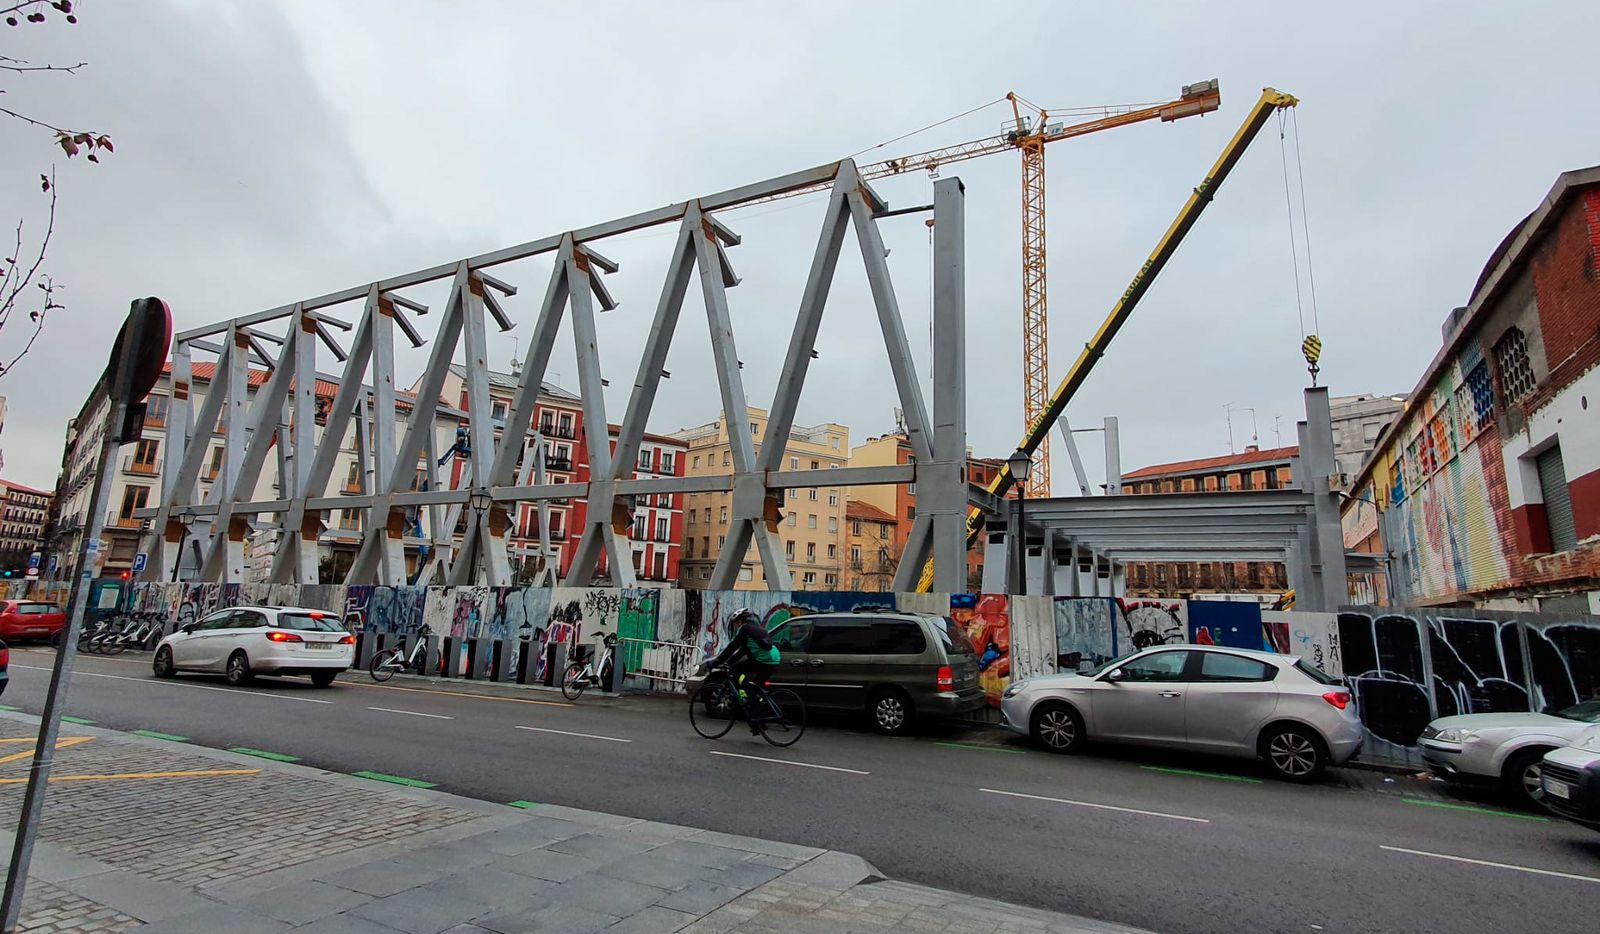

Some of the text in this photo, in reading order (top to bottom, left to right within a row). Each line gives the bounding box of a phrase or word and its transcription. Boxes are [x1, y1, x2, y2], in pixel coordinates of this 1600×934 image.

[1120, 259, 1153, 304] AGUILAR
[1026, 399, 1055, 441] AGUILAR
[135, 555, 144, 569] P
